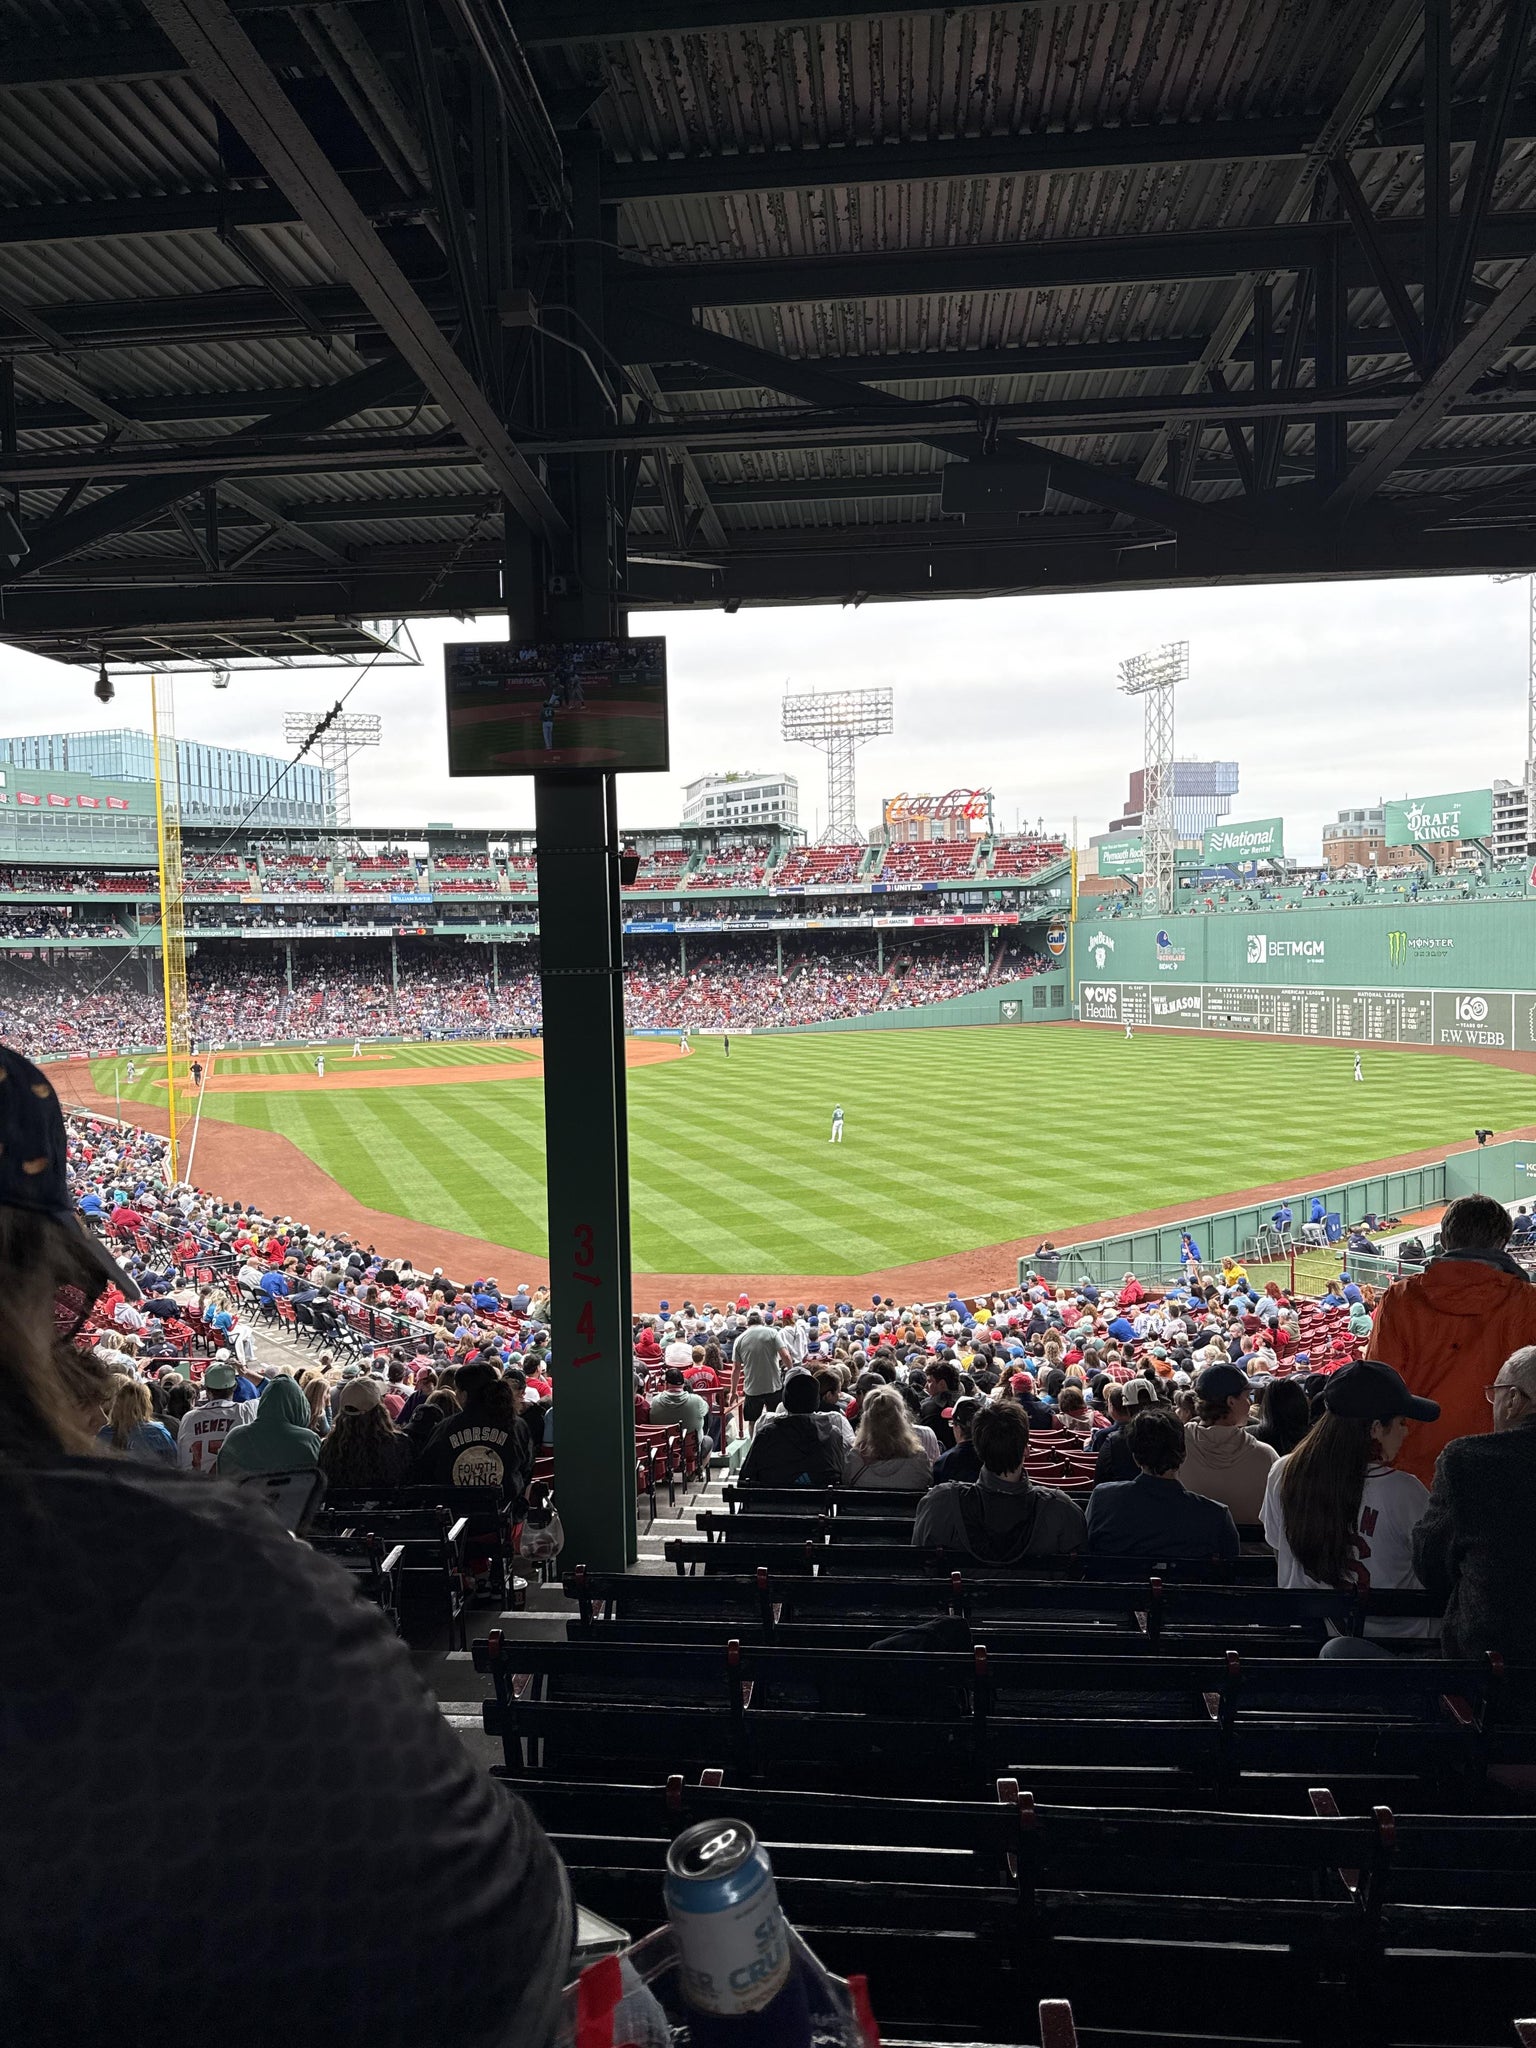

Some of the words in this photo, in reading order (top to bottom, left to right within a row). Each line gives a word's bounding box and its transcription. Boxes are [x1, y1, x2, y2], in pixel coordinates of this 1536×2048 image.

[886, 787, 990, 825] Coca-Cola
[1407, 811, 1461, 831] DRAFT
[1223, 827, 1274, 849] National
[1414, 824, 1460, 841] KINGS
[1103, 849, 1128, 863] Plymouth
[1251, 845, 1271, 855] Rental
[894, 883, 923, 892] UNITED
[1047, 932, 1066, 944] Gulf
[1407, 938, 1455, 948] MONSTER
[1269, 940, 1325, 956] BETMGM
[1094, 986, 1117, 1004] CVS
[1085, 1002, 1118, 1019] Health
[1455, 996, 1488, 1021] 160
[1440, 1029, 1463, 1043] F.W.
[1465, 1030, 1505, 1046] WEBB
[573, 1223, 594, 1268] 3
[576, 1299, 597, 1345] 4
[448, 1425, 510, 1449] RIORSON
[458, 1462, 498, 1474] FOURTH
[458, 1473, 498, 1486] WING
